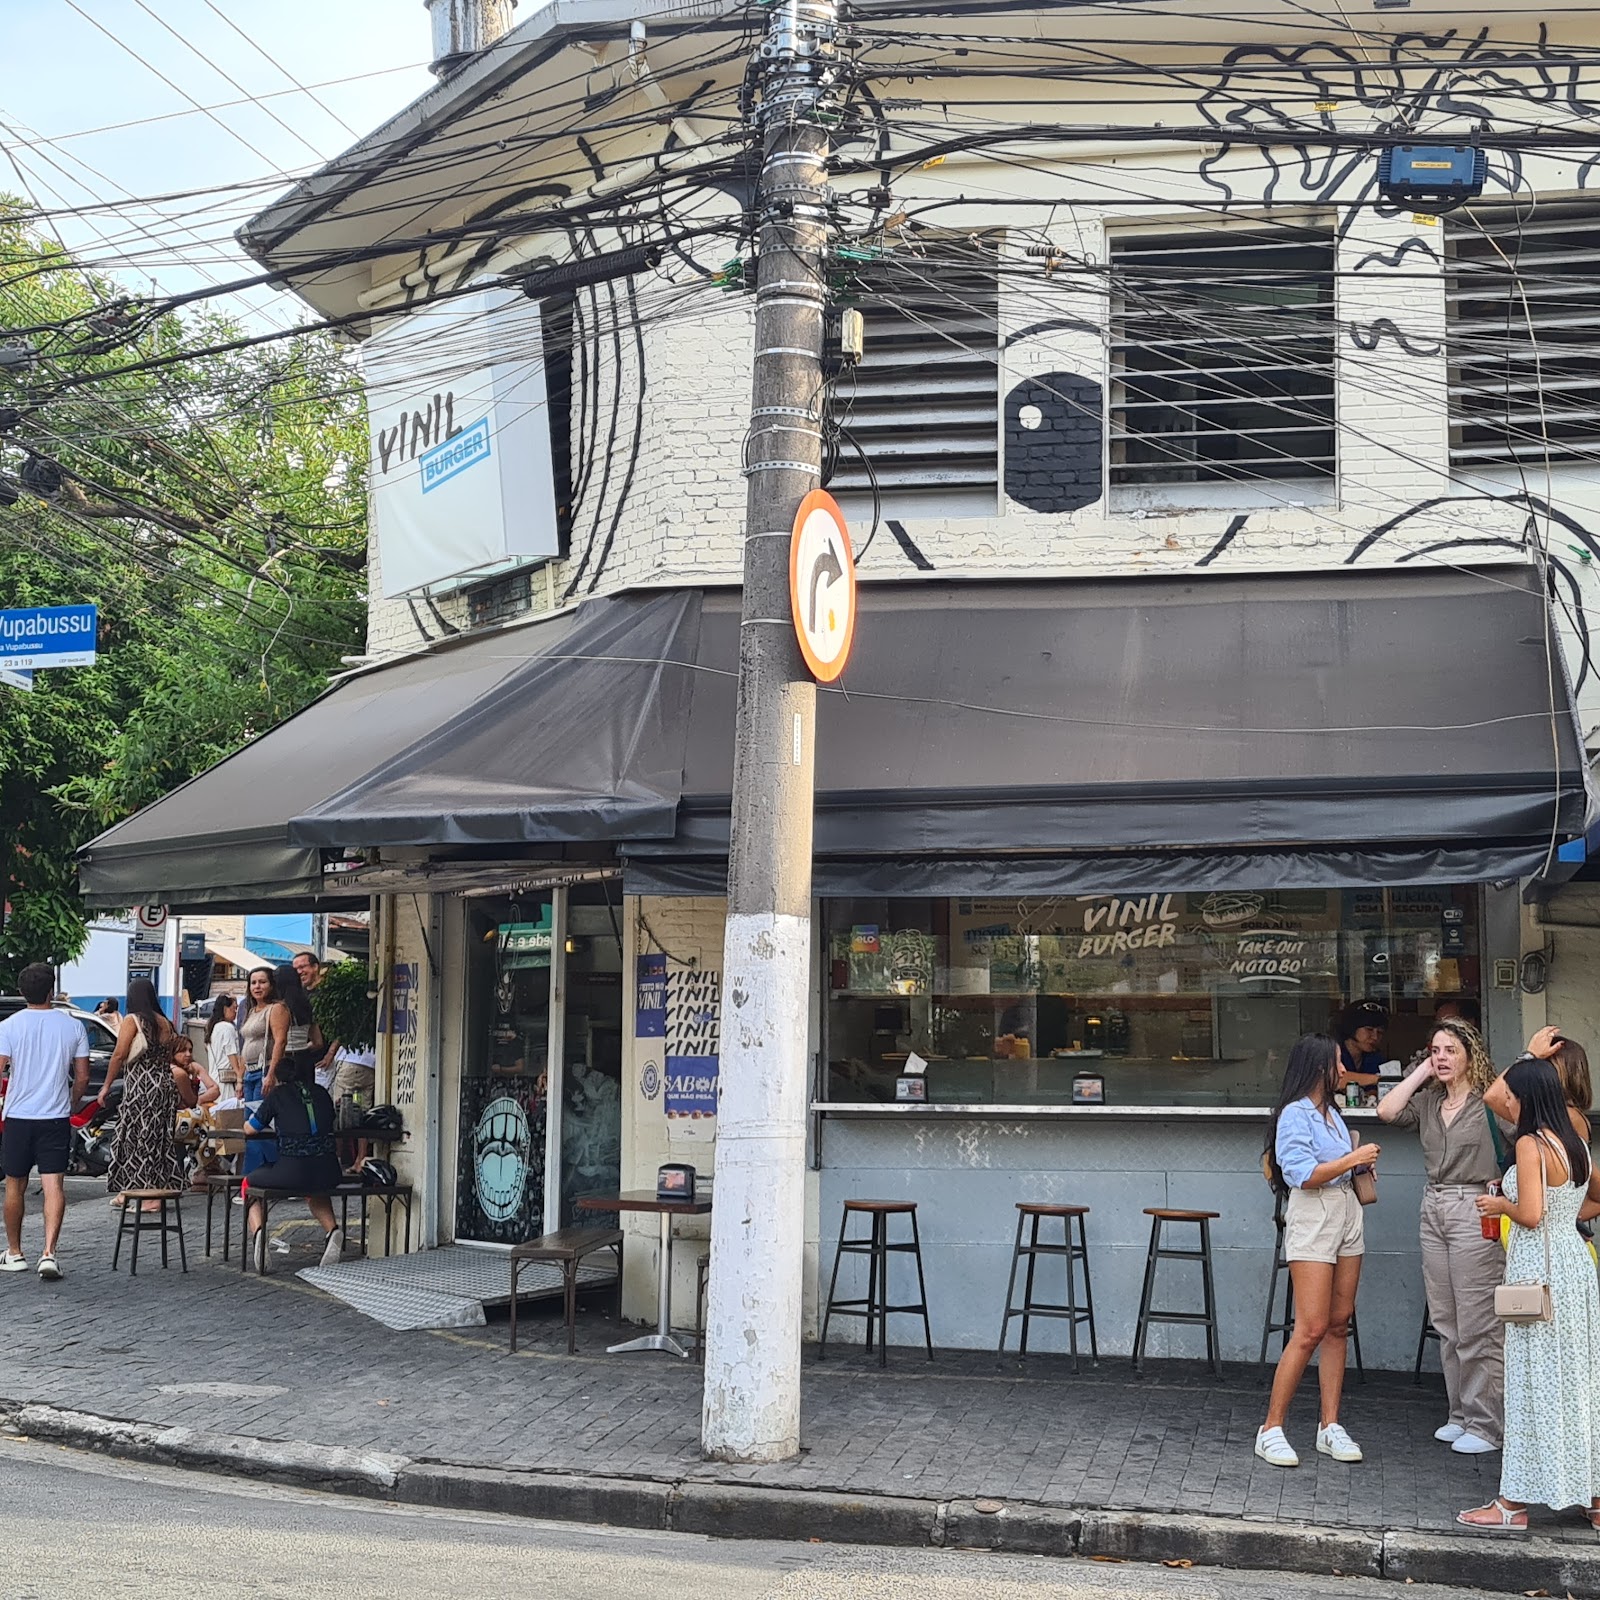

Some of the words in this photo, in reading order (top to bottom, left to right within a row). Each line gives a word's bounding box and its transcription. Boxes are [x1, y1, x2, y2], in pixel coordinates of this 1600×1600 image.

[379, 391, 464, 475] VINIL
[425, 431, 484, 482] BURGER
[5, 643, 43, 652] Vupabussu
[1083, 893, 1179, 932] VINIL
[1078, 923, 1176, 958] BURGER
[1237, 940, 1307, 955] TAKE-OUT
[639, 991, 664, 1009] VINIL
[664, 1040, 719, 1056] VINIL
